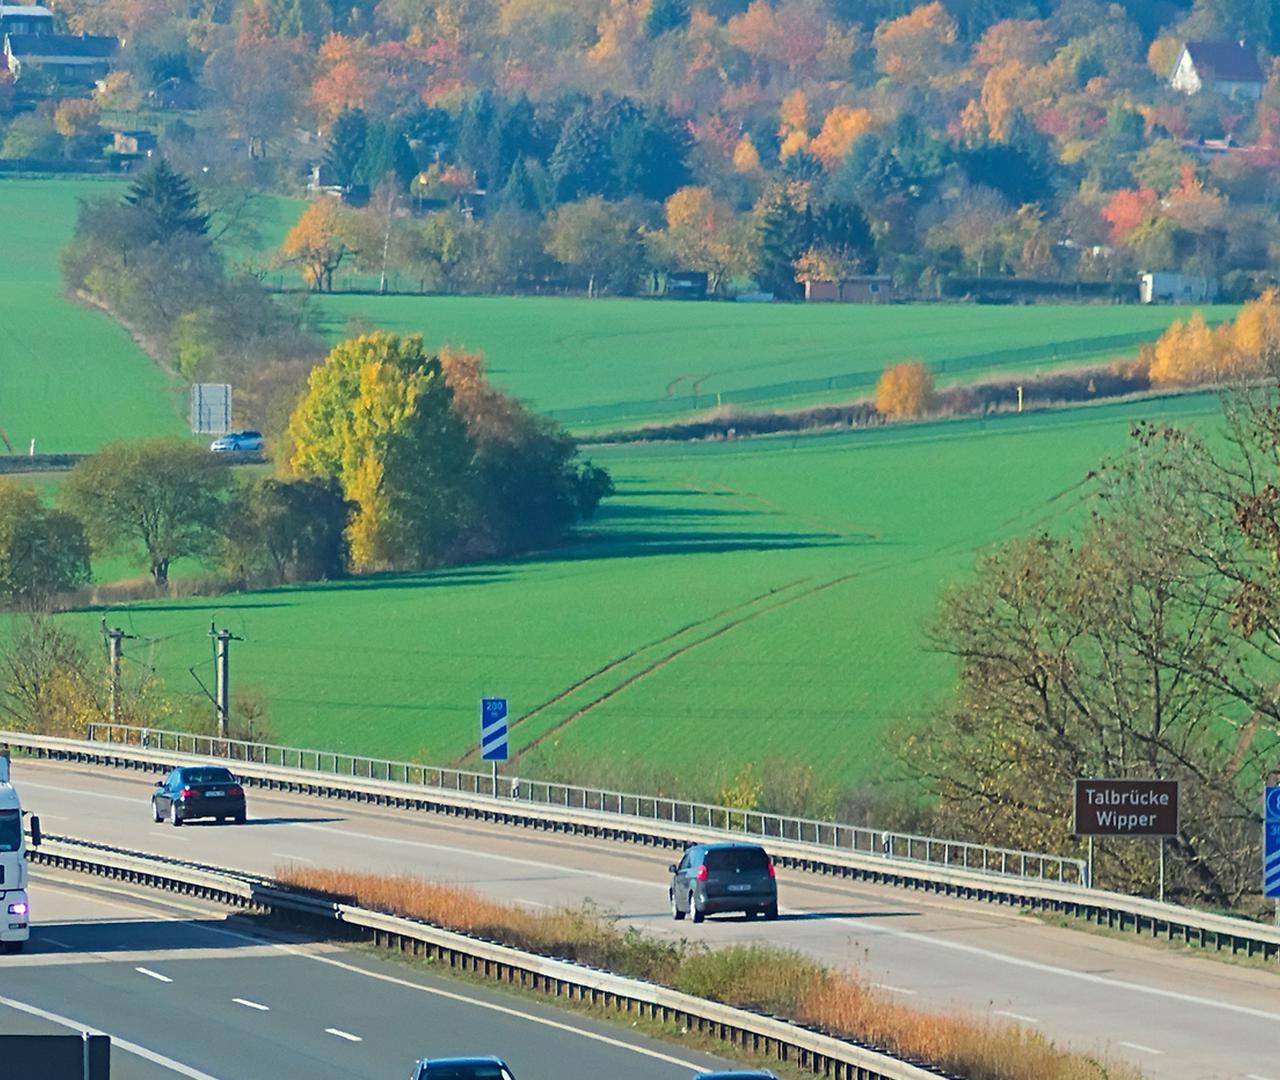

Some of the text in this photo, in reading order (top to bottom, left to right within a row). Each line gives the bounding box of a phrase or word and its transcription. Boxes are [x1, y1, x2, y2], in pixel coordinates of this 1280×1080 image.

[486, 701, 503, 711] 200
[1086, 789, 1169, 805] Talbrücke
[1096, 810, 1157, 830] Wipper
